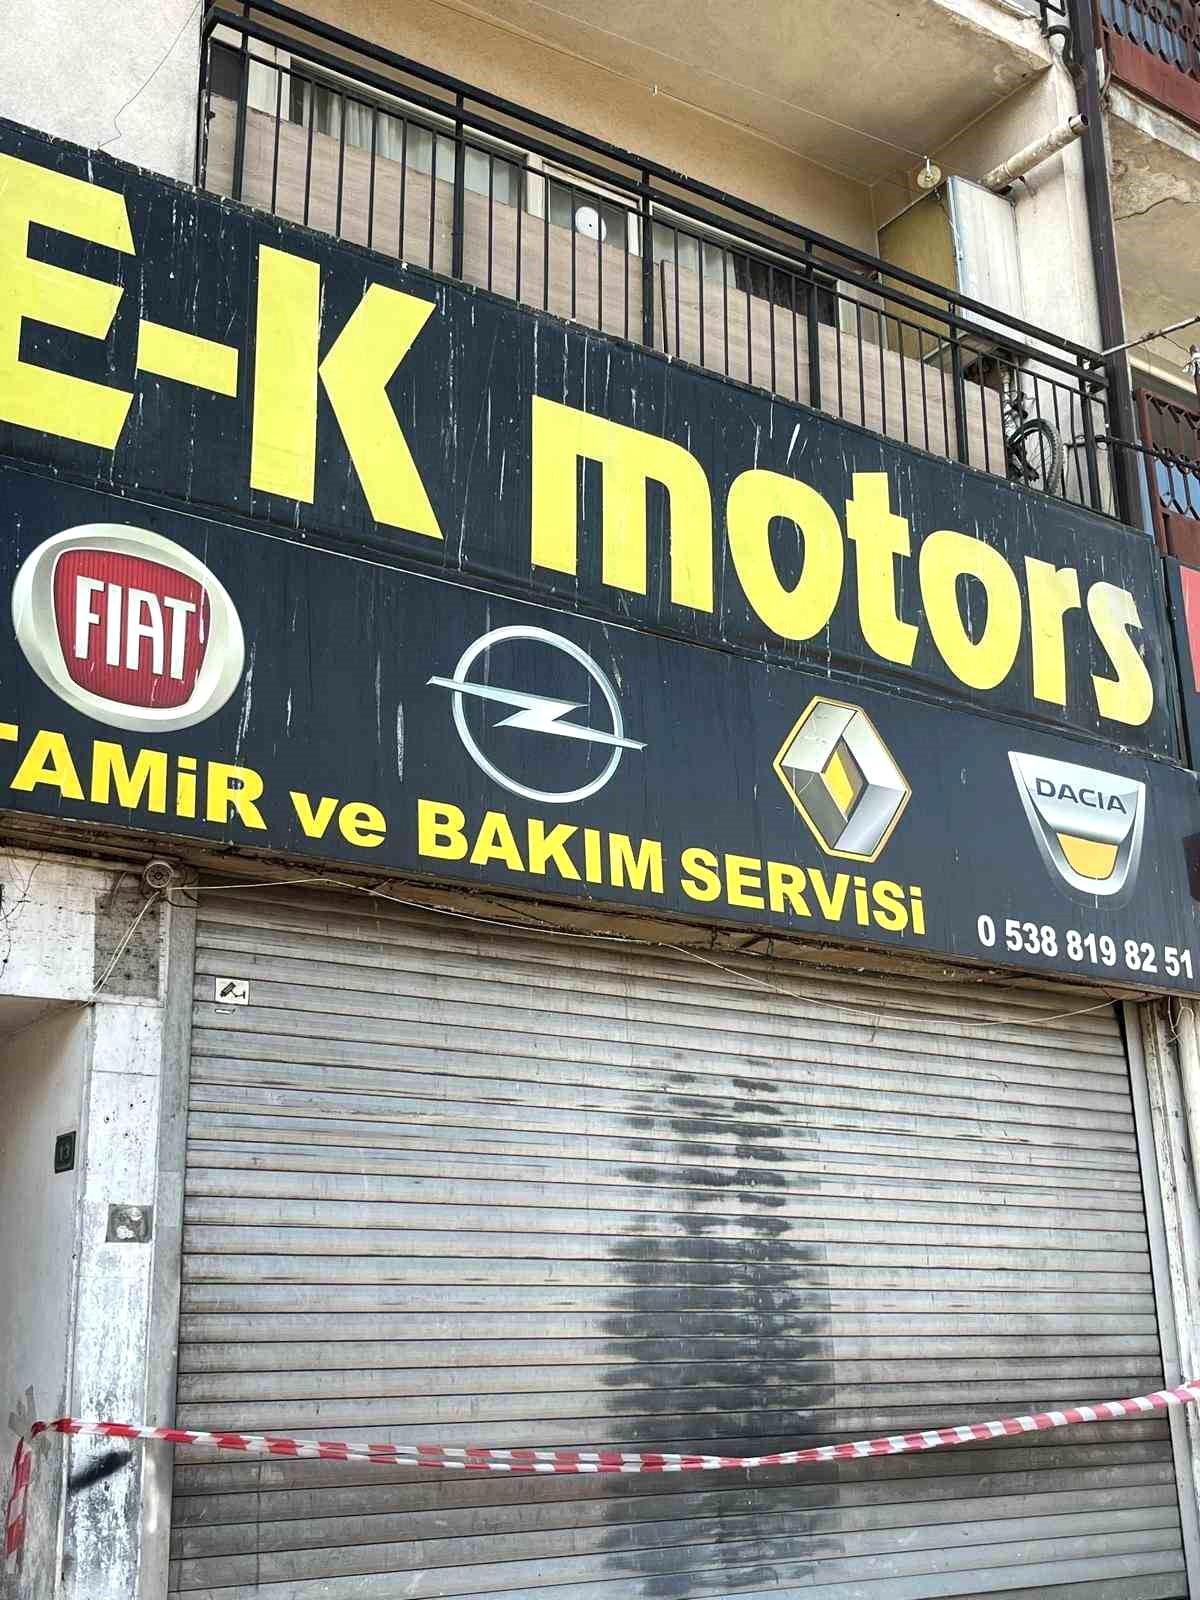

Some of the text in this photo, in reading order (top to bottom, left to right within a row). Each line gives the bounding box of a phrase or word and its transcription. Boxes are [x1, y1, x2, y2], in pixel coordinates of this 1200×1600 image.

[0, 153, 1154, 728] E-K motors
[73, 575, 197, 681] FIAT
[0, 721, 268, 830] AMiR
[289, 790, 387, 849] ve
[416, 798, 664, 895] BAKIM
[1035, 777, 1127, 815] DACIA
[977, 914, 1194, 979] 0 538 819 82 51
